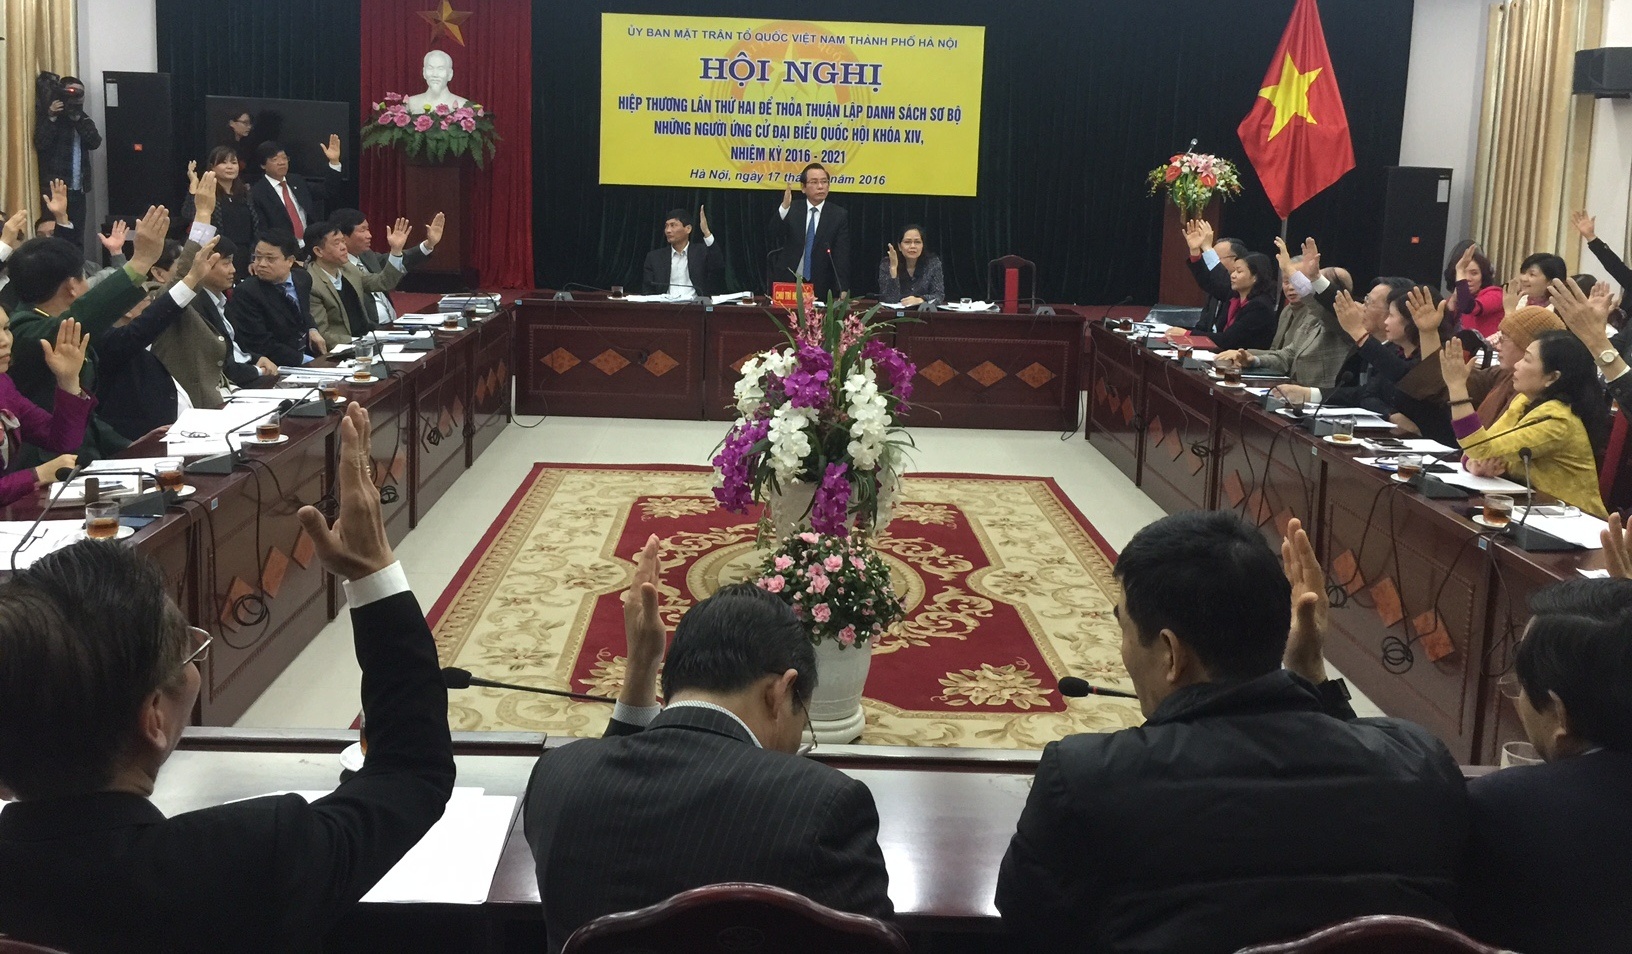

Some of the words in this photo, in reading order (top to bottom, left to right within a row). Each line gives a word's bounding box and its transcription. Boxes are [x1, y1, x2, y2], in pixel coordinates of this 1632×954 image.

[628, 24, 643, 36] ỦY
[647, 28, 671, 38] BAN
[674, 28, 698, 41] MẶT
[702, 29, 733, 42] TRẬN
[736, 27, 751, 41] TỔ
[755, 29, 788, 42] QUỐC
[792, 32, 816, 45] VIỆT
[820, 35, 845, 44] NAM
[850, 34, 888, 46] THÀNH
[891, 35, 916, 47] PHỐ
[918, 37, 934, 48] HÀ
[938, 37, 958, 50] NỘI
[700, 51, 770, 87] HỘI
[783, 61, 882, 92] NGHỊ
[618, 94, 642, 113] HIỆP
[646, 96, 688, 113] THƯƠNG
[691, 94, 712, 113] LẦN
[715, 96, 736, 114] THỨ
[738, 101, 755, 115] HAI
[758, 96, 772, 115] ĐỂ
[776, 97, 802, 116] THỎA
[806, 101, 840, 120] THUẬN
[844, 102, 863, 121] LẬP
[866, 105, 895, 120] DANH
[899, 103, 926, 121] SÁCH
[930, 106, 945, 122] SƠ
[947, 105, 961, 125] BỘ
[654, 117, 691, 135] NHỮNG
[695, 119, 726, 137] NGƯỜI
[730, 120, 752, 138] ỨNG
[755, 119, 771, 138] CỬ
[773, 125, 790, 142] ĐẠI
[793, 121, 817, 140] BIỂU
[821, 122, 849, 142] QUỐC
[852, 125, 869, 144] HỘI
[873, 126, 901, 143] KHÓA
[904, 129, 924, 145] XIV,
[731, 144, 765, 163] NHIỆM
[768, 145, 782, 161] KỲ
[785, 148, 811, 162] 2016
[821, 150, 846, 164] 2021
[690, 169, 706, 179] Hà
[709, 169, 731, 181] Nội,
[735, 171, 763, 183] ngày
[768, 172, 780, 181] 17
[784, 172, 801, 182] thá
[859, 175, 886, 185] 2016
